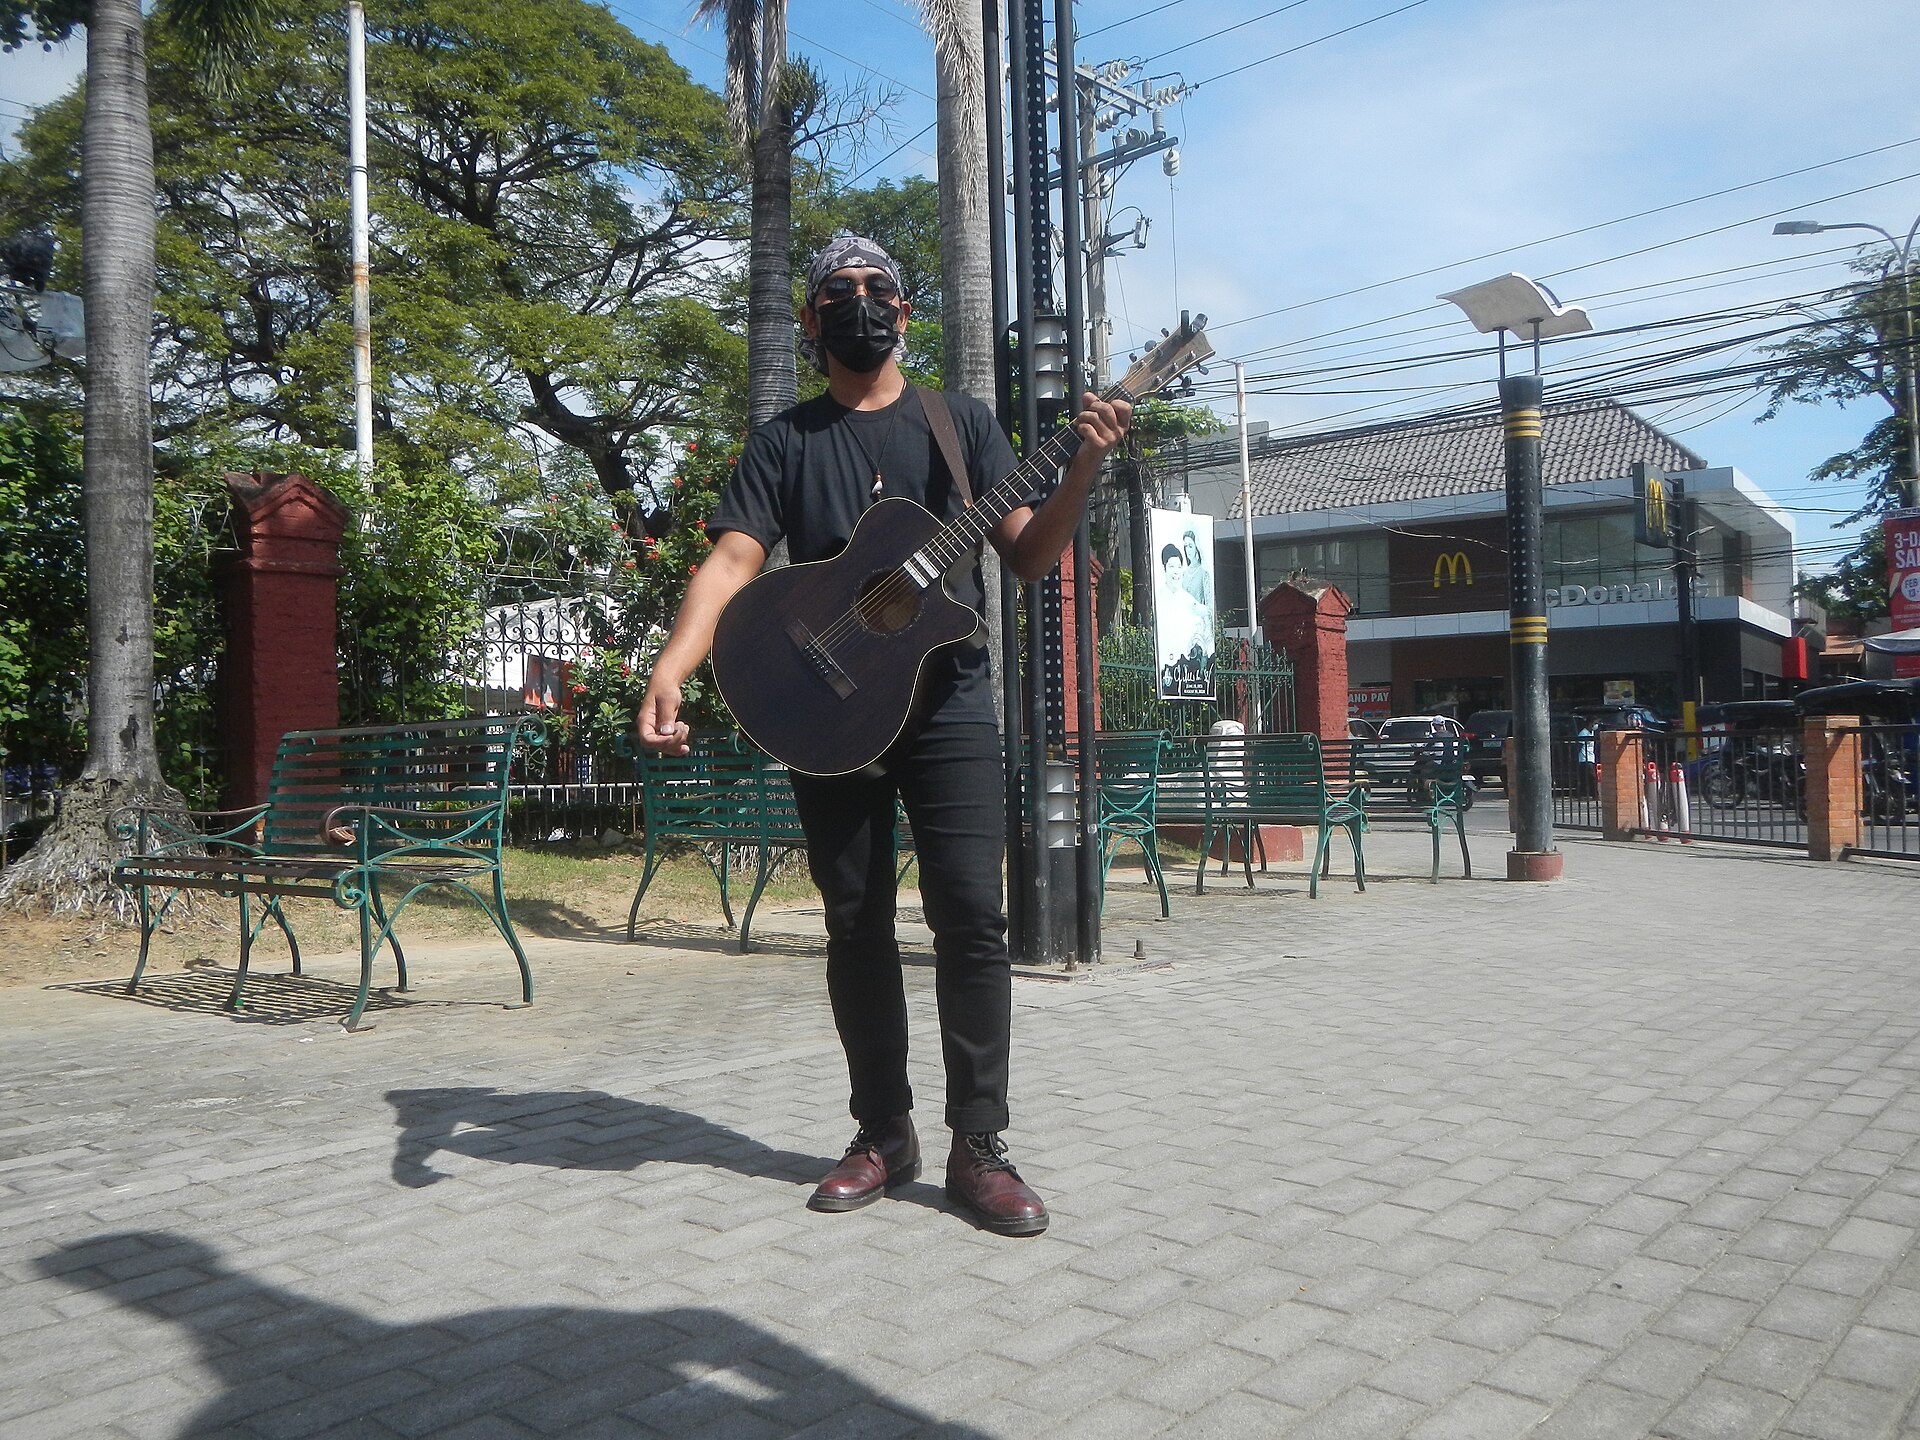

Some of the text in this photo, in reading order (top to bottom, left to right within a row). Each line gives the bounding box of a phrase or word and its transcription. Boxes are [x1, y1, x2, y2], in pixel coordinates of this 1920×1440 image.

[1894, 531, 1920, 549] 3-D
[1348, 692, 1390, 704] AND PAY
